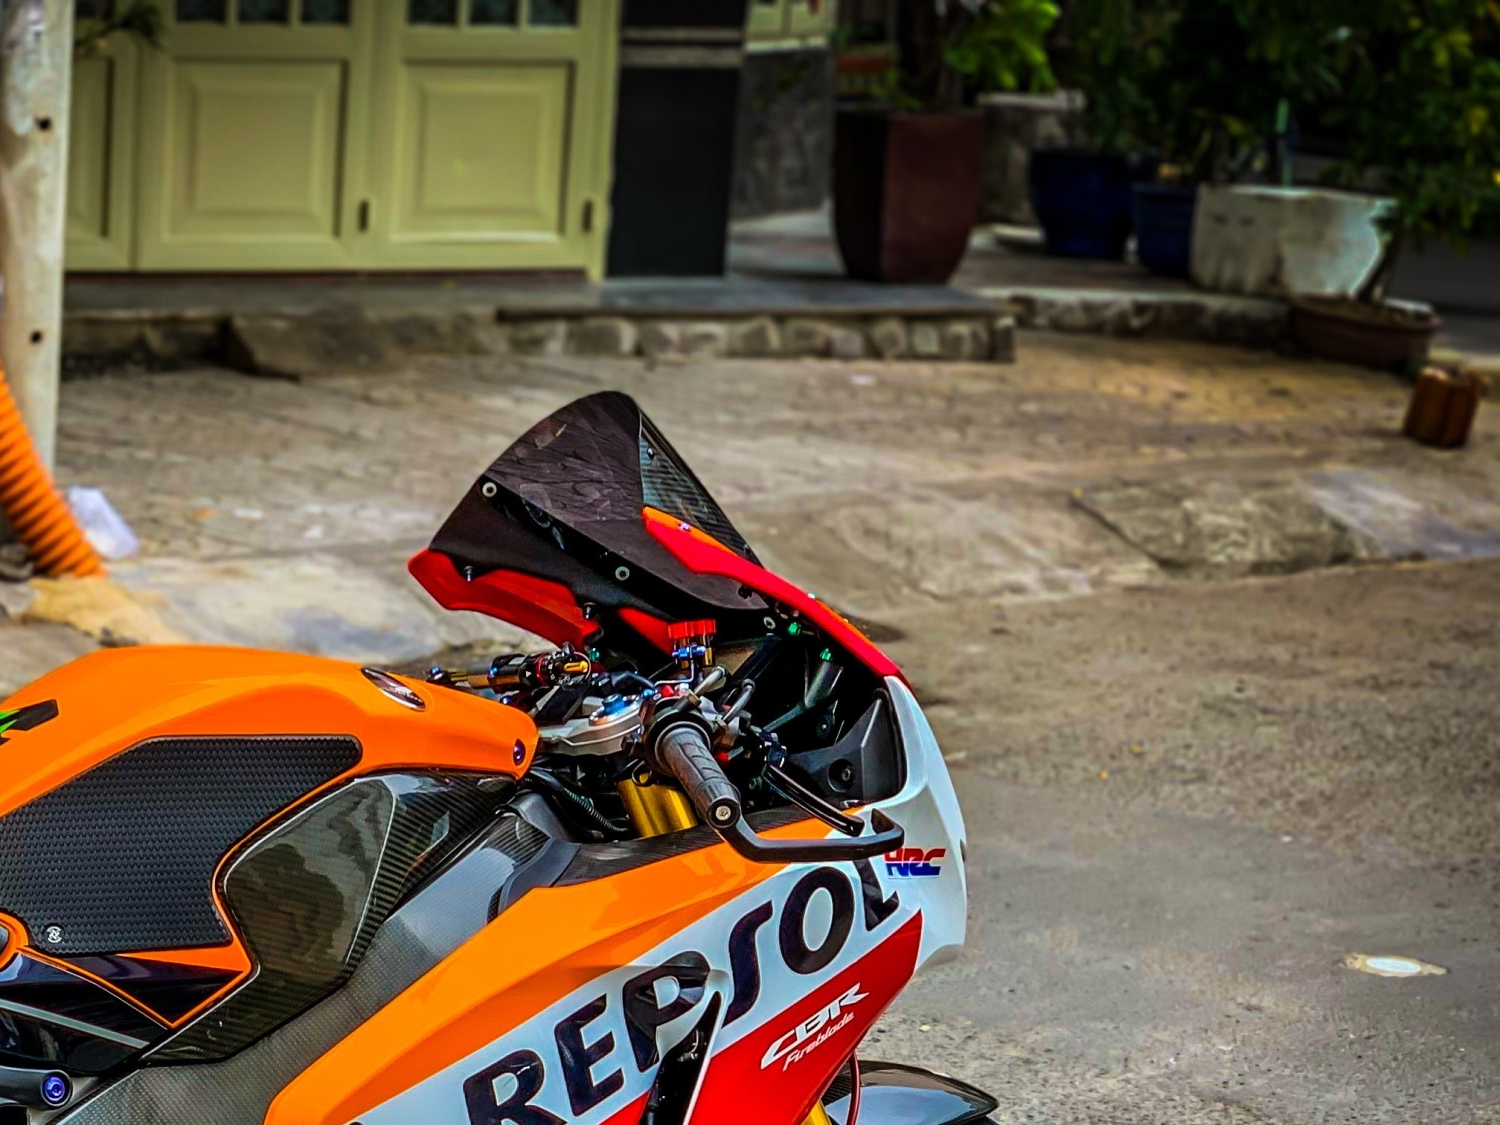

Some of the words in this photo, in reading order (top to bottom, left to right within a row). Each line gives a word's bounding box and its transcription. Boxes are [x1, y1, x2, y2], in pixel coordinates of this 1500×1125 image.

[884, 847, 947, 877] HRC
[760, 981, 870, 1071] CBR
[782, 1011, 855, 1072] Fireblade
